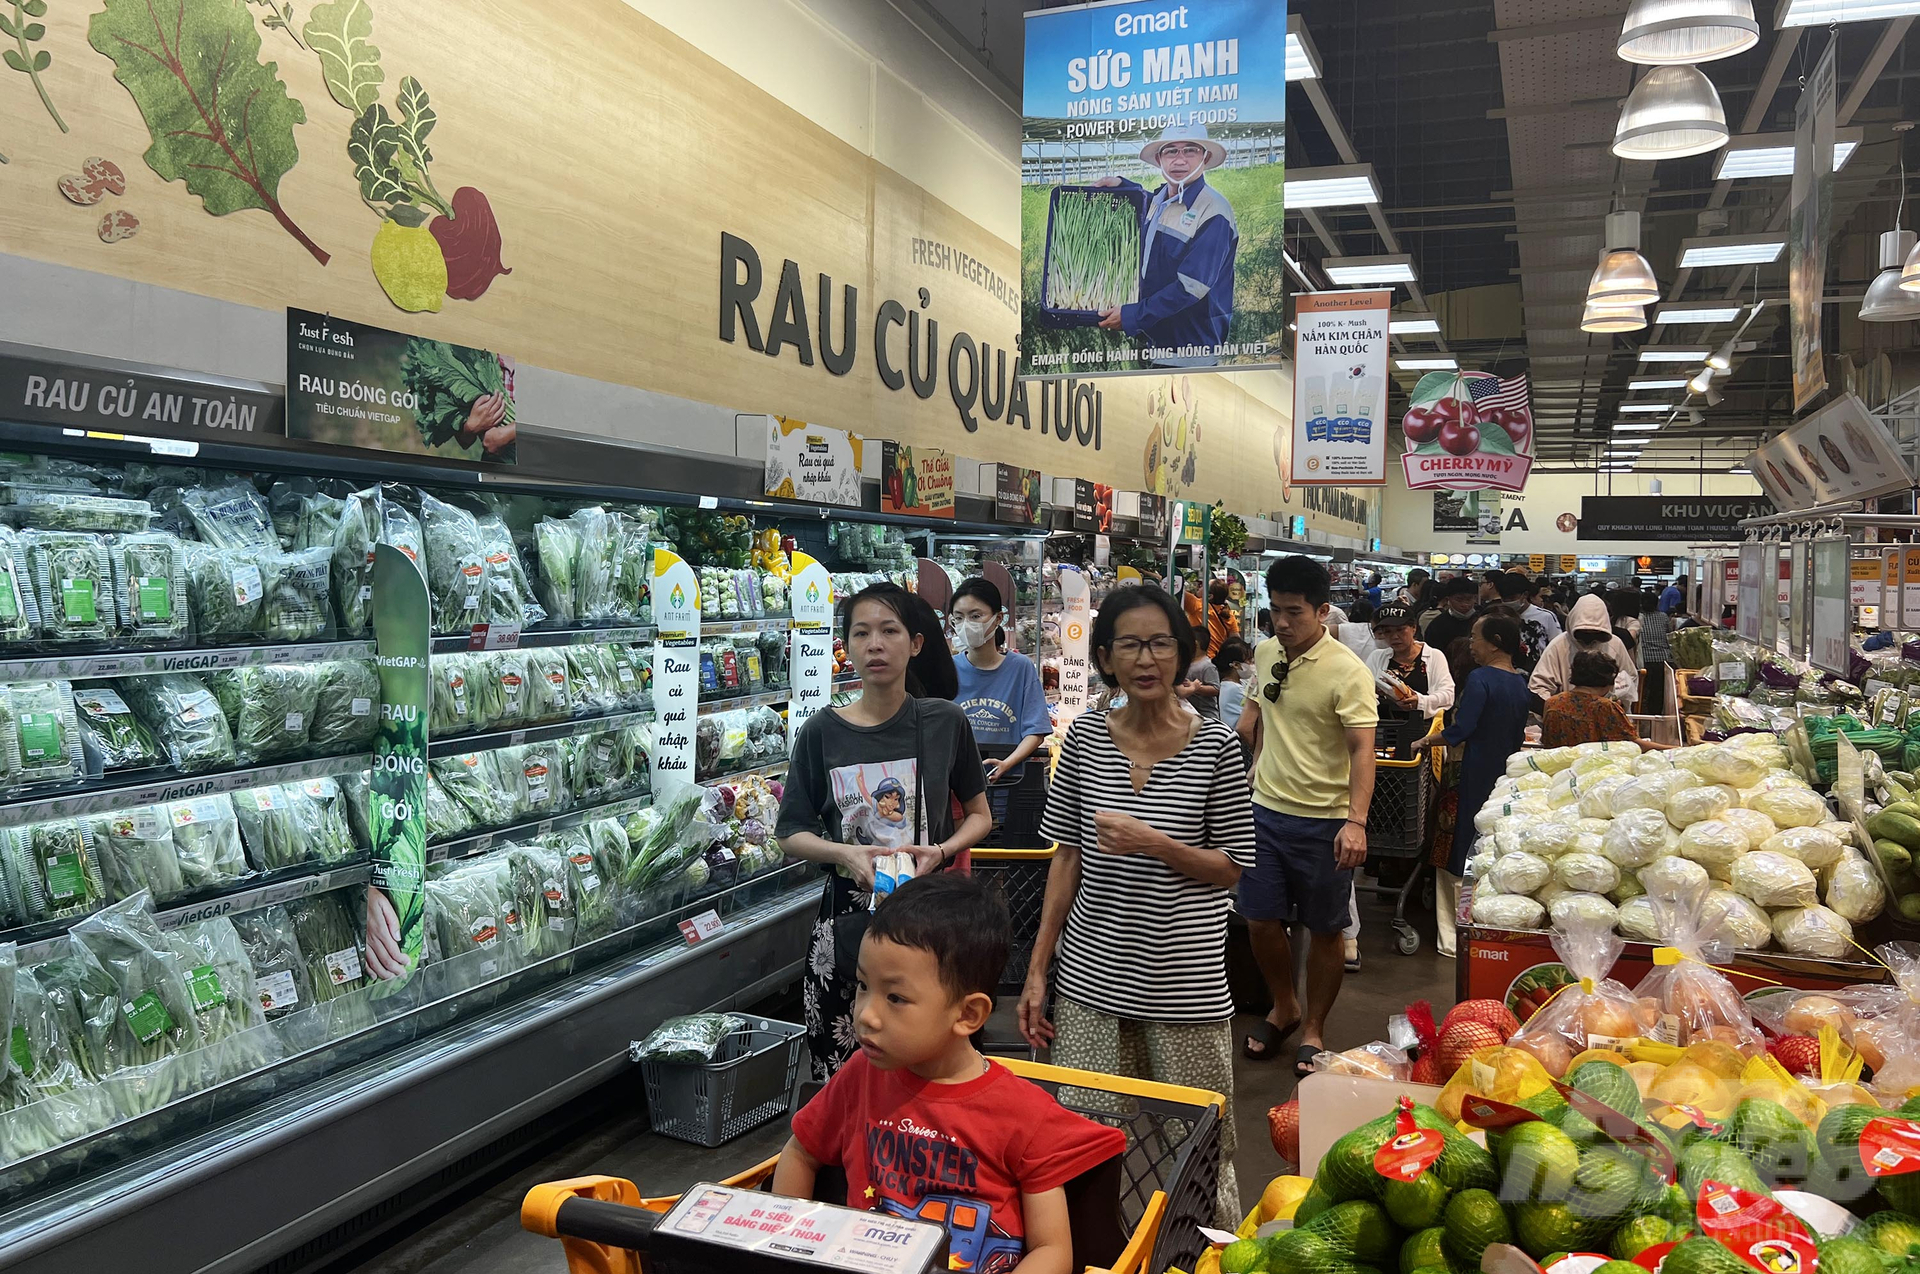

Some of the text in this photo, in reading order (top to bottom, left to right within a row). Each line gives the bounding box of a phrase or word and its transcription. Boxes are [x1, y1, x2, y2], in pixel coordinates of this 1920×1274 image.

[1114, 5, 1188, 37] emart
[1066, 38, 1239, 94] SỨC MẠNH
[1066, 83, 1238, 118] NÔNG SẢN VIỆT NAM
[1066, 107, 1238, 138] POWER OF LOCAL FOODS
[911, 236, 1020, 316] FRESH VEGETABLES
[1313, 297, 1373, 308] Another Level
[719, 231, 859, 377] RAU
[875, 286, 938, 400] CỦ
[948, 331, 1031, 433] QUẢ
[1317, 320, 1337, 329] 100%
[299, 322, 354, 347] Just Fesh
[1302, 327, 1383, 342] NẤM KIM CHÂM
[1031, 339, 1269, 367] EMART ĐỒNG HÀNH CÙNG NÔNG DÂN VIỆT
[1314, 340, 1369, 356] HÀN QUỐC
[299, 373, 419, 410] RAU ĐÓNG GÓI
[24, 375, 257, 432] RAU CỦ AN TOÀN
[315, 401, 401, 425] TIÊU CHUẨN VIETGAP
[798, 452, 835, 473] Rau củ quả
[1420, 457, 1514, 473] CHERRY MỸ
[802, 472, 831, 487] nhập khẩu
[927, 475, 953, 491] Chuông
[1661, 504, 1701, 518] KHU
[1704, 503, 1744, 521] VỰC
[1066, 596, 1085, 604] FRESH
[797, 621, 820, 629] Premium
[801, 627, 829, 635] Vegetables
[659, 632, 685, 640] Premium
[664, 638, 696, 648] Vegetables
[800, 643, 825, 657] Rau
[163, 655, 219, 671] VietGAP
[375, 655, 418, 668] VietGAP
[664, 658, 691, 674] Rau
[804, 665, 818, 677] củ
[1065, 668, 1081, 679] CẤP
[668, 684, 683, 697] củ
[800, 687, 821, 704] quả
[1062, 682, 1084, 693] KHÁC
[1064, 696, 1081, 708] BIỆT
[379, 703, 417, 722] RAU
[663, 707, 686, 727] quả
[659, 731, 689, 750] nhập
[373, 750, 424, 776] ĐÓNG
[657, 756, 688, 771] khẩu
[838, 795, 864, 809] FASHION
[845, 792, 861, 801] FALL
[380, 798, 413, 821] GÓI
[373, 862, 421, 880] Just Fresh
[176, 898, 231, 927] VietGAP
[1469, 946, 1509, 962] emart
[897, 1118, 938, 1139] Series
[723, 1213, 758, 1230] BẰNG
[750, 1208, 766, 1219] ĐI
[765, 1211, 794, 1224] SIÊU
[852, 1223, 913, 1246] emart
